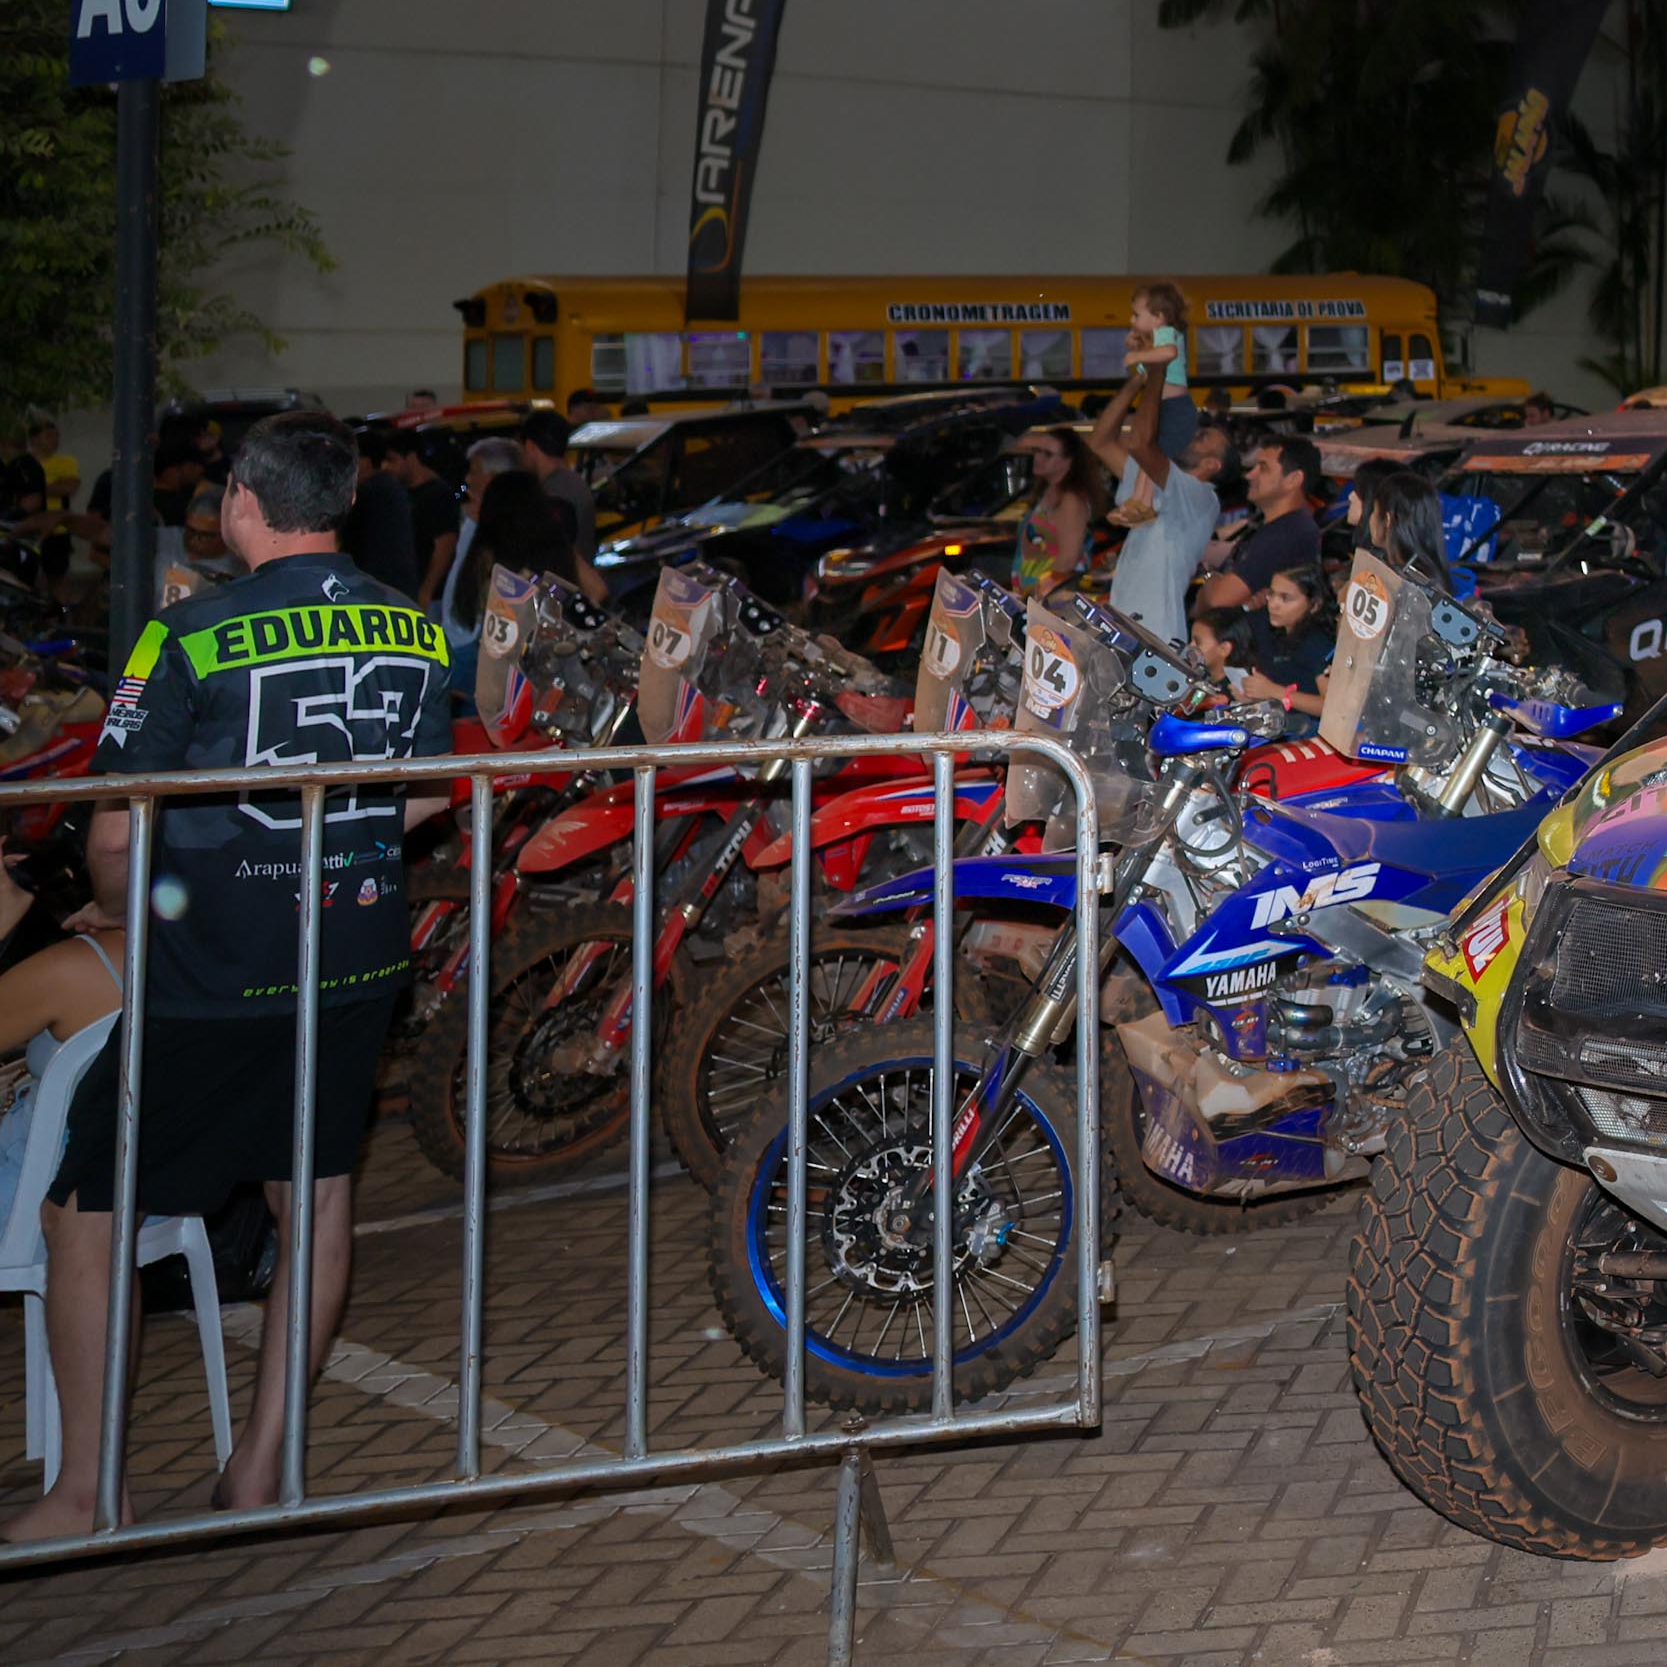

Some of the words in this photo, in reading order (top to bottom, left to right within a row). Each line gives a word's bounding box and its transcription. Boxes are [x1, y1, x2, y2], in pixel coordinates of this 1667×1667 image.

[888, 302, 1071, 324] CRONOMETRAGEM
[1206, 300, 1295, 321] SECRETARIA
[1317, 300, 1367, 319] PROVA
[1352, 588, 1380, 629] 05
[213, 609, 439, 663] EDUARDO
[485, 614, 510, 642] 03
[653, 622, 683, 656] 07
[1031, 644, 1067, 694] 04
[1360, 746, 1405, 760] CHAPAM
[1246, 862, 1382, 931] IMS
[1205, 960, 1277, 1000] YAMAHA
